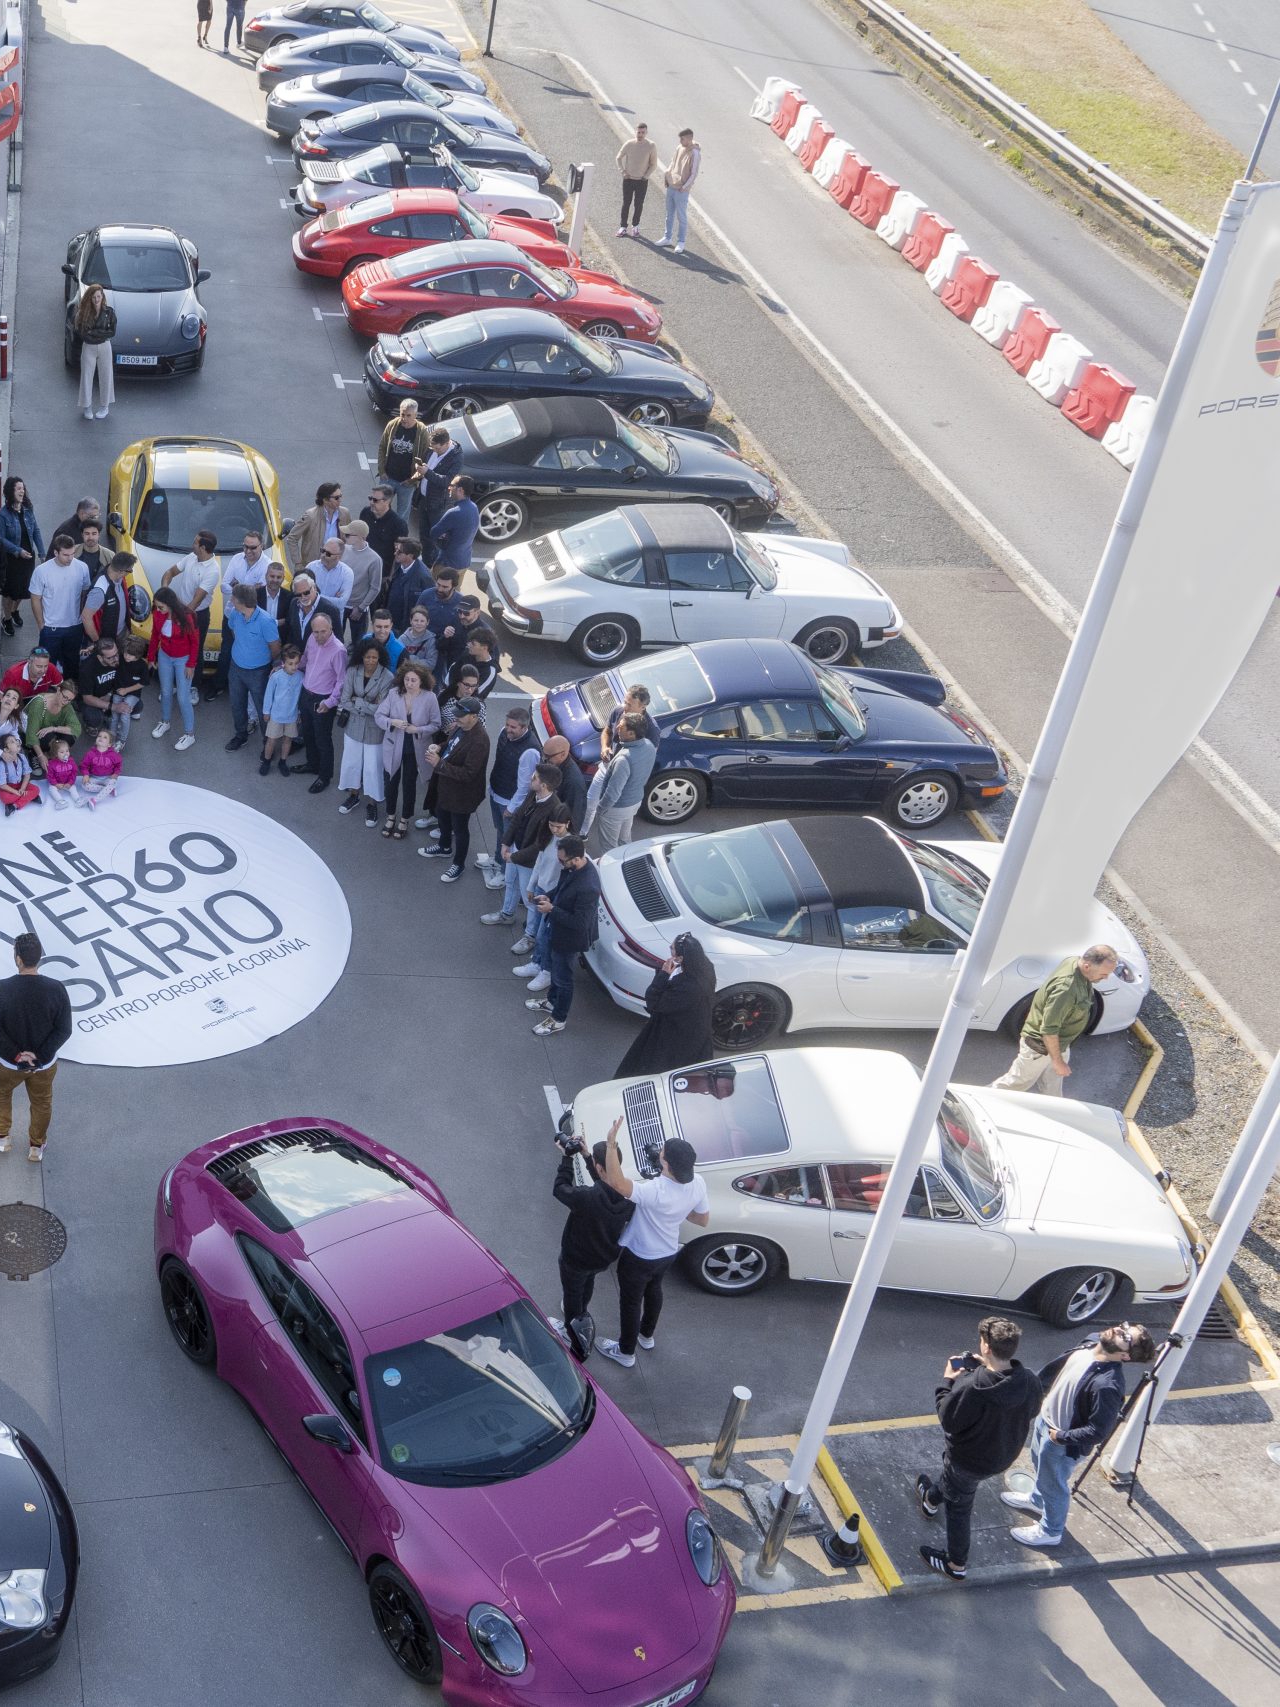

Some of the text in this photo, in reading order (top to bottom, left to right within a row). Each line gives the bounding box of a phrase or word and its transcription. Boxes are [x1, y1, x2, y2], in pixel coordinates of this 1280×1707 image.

[133, 831, 238, 894] 60
[76, 937, 311, 1033] CENTRO PORSCHE A CORUÑA
[201, 1005, 257, 1030] PORSCHE
